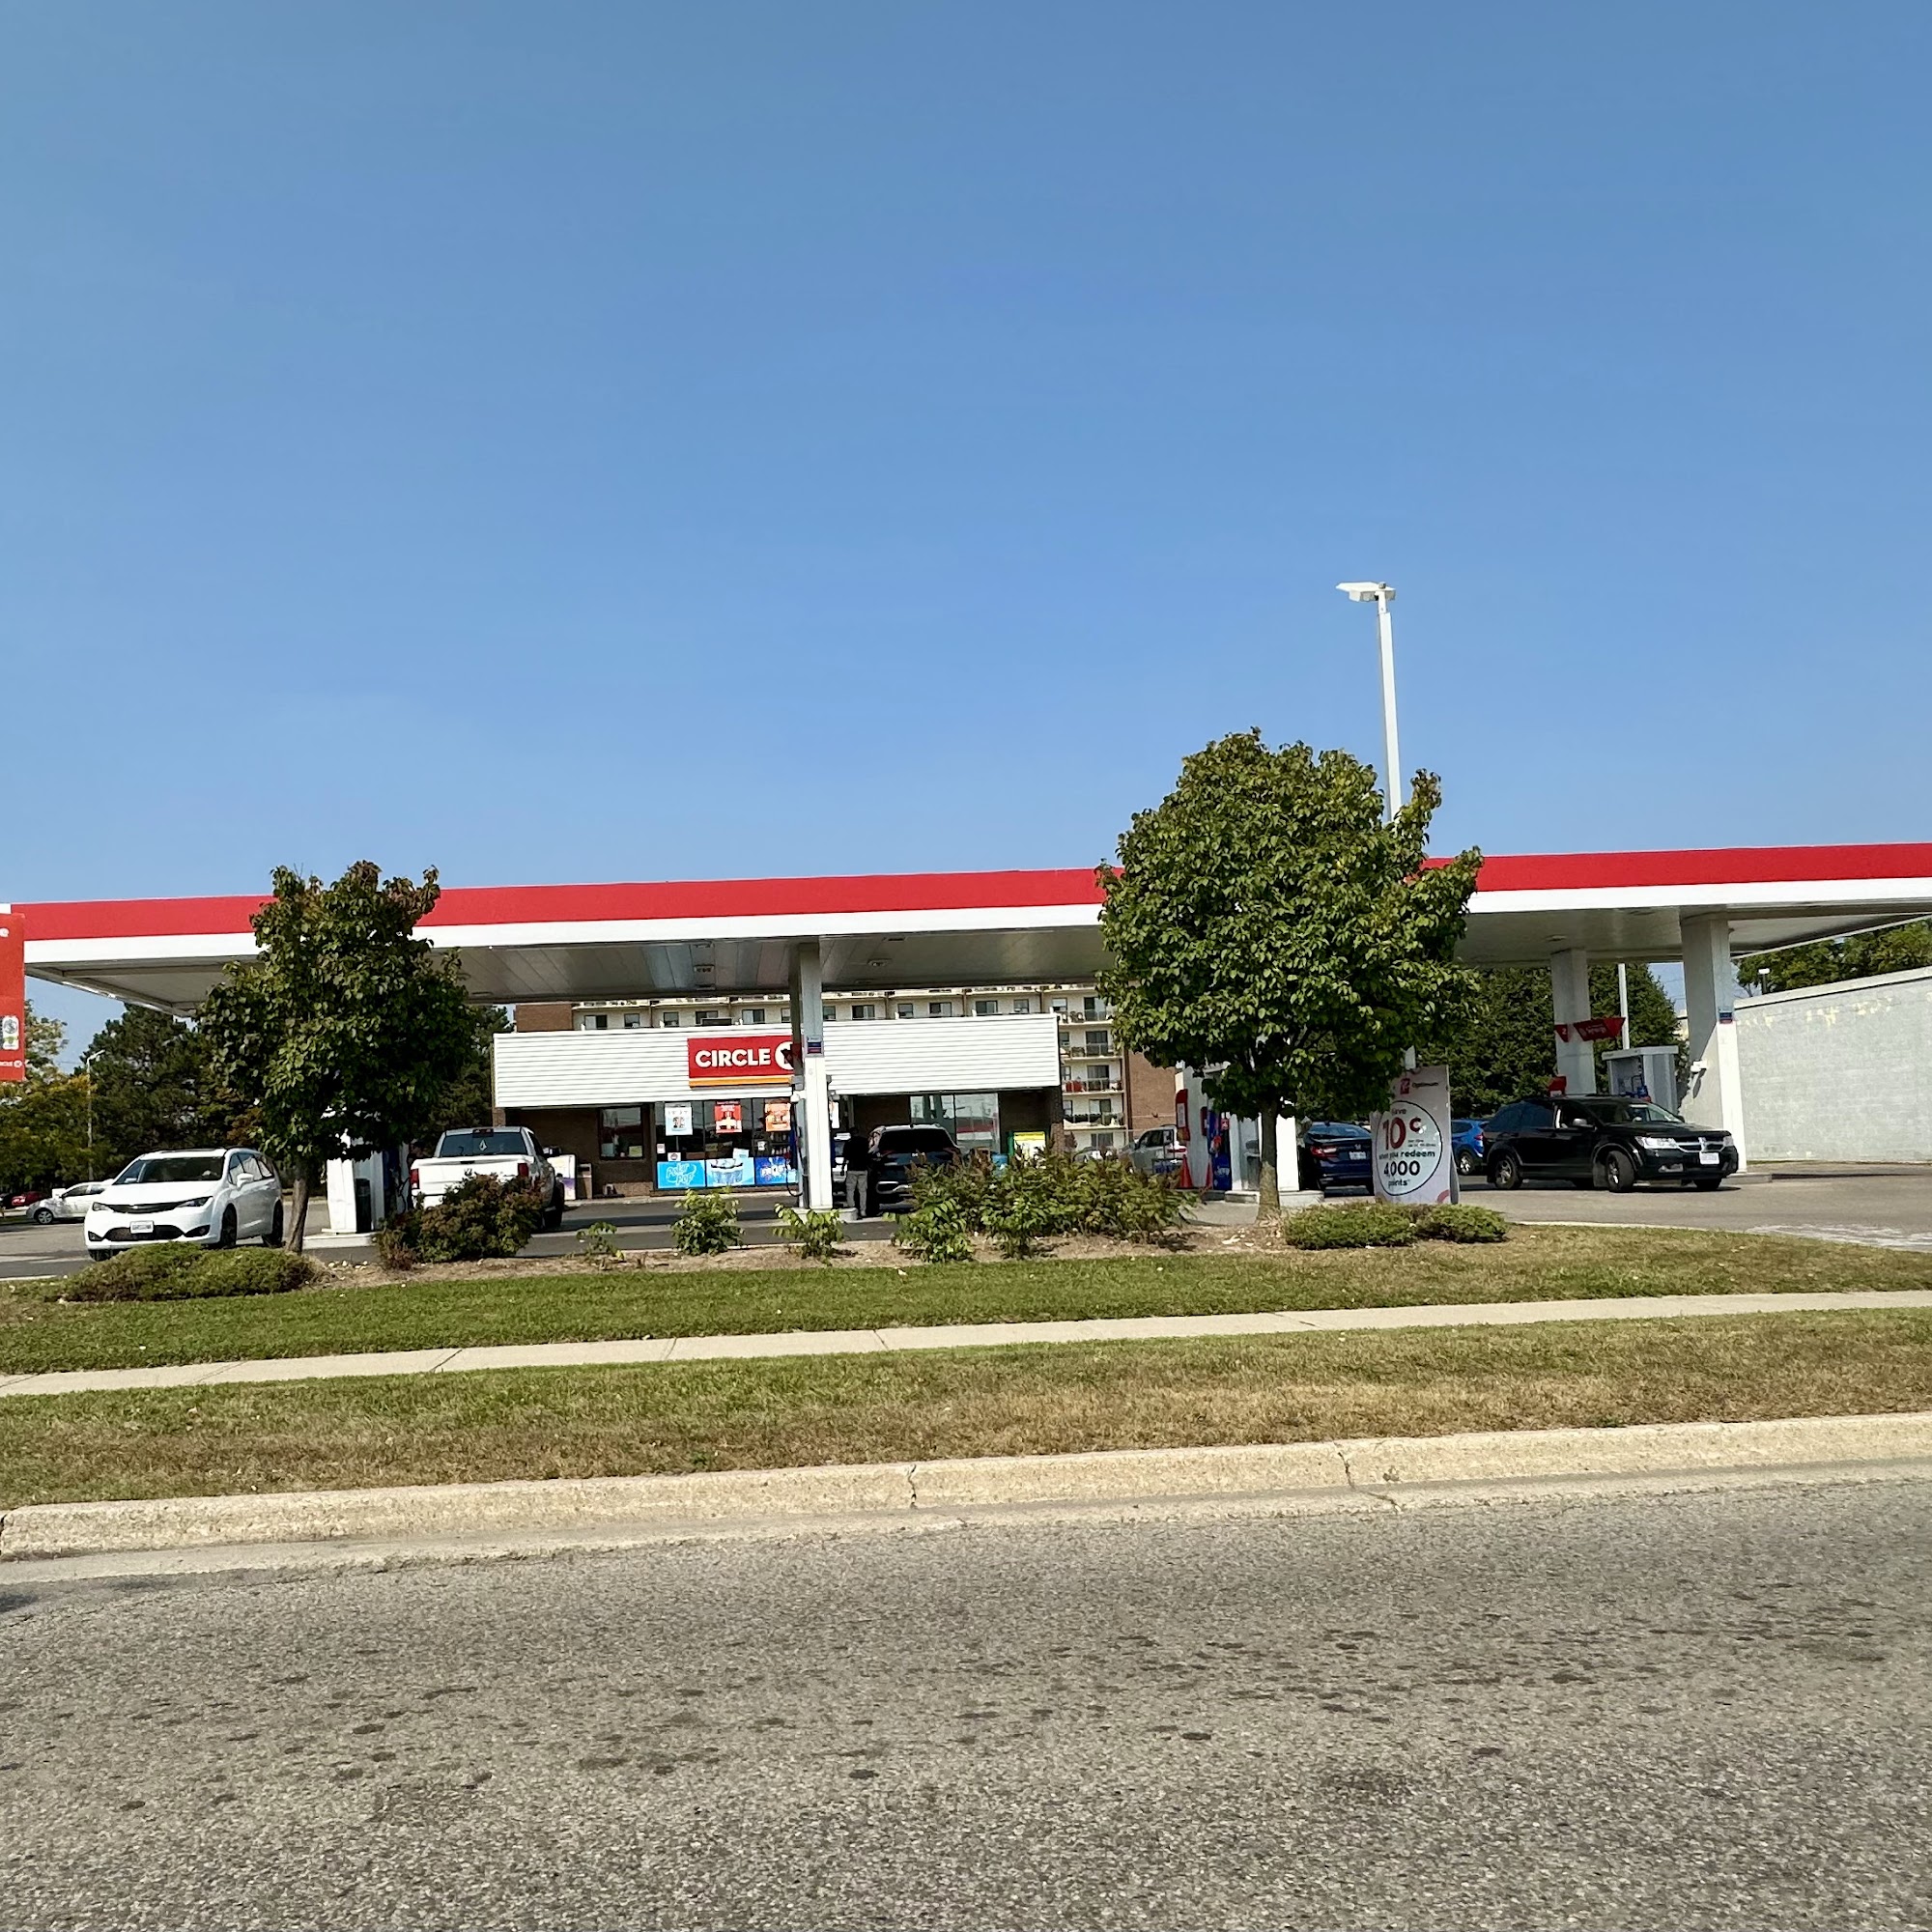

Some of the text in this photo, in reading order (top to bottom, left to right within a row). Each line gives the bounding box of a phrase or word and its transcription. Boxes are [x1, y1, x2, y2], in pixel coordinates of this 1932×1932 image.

[696, 1048, 771, 1067] CIRCLE
[1400, 1149, 1435, 1158] redeem
[667, 1163, 689, 1178] Polar
[676, 1174, 693, 1184] Pop
